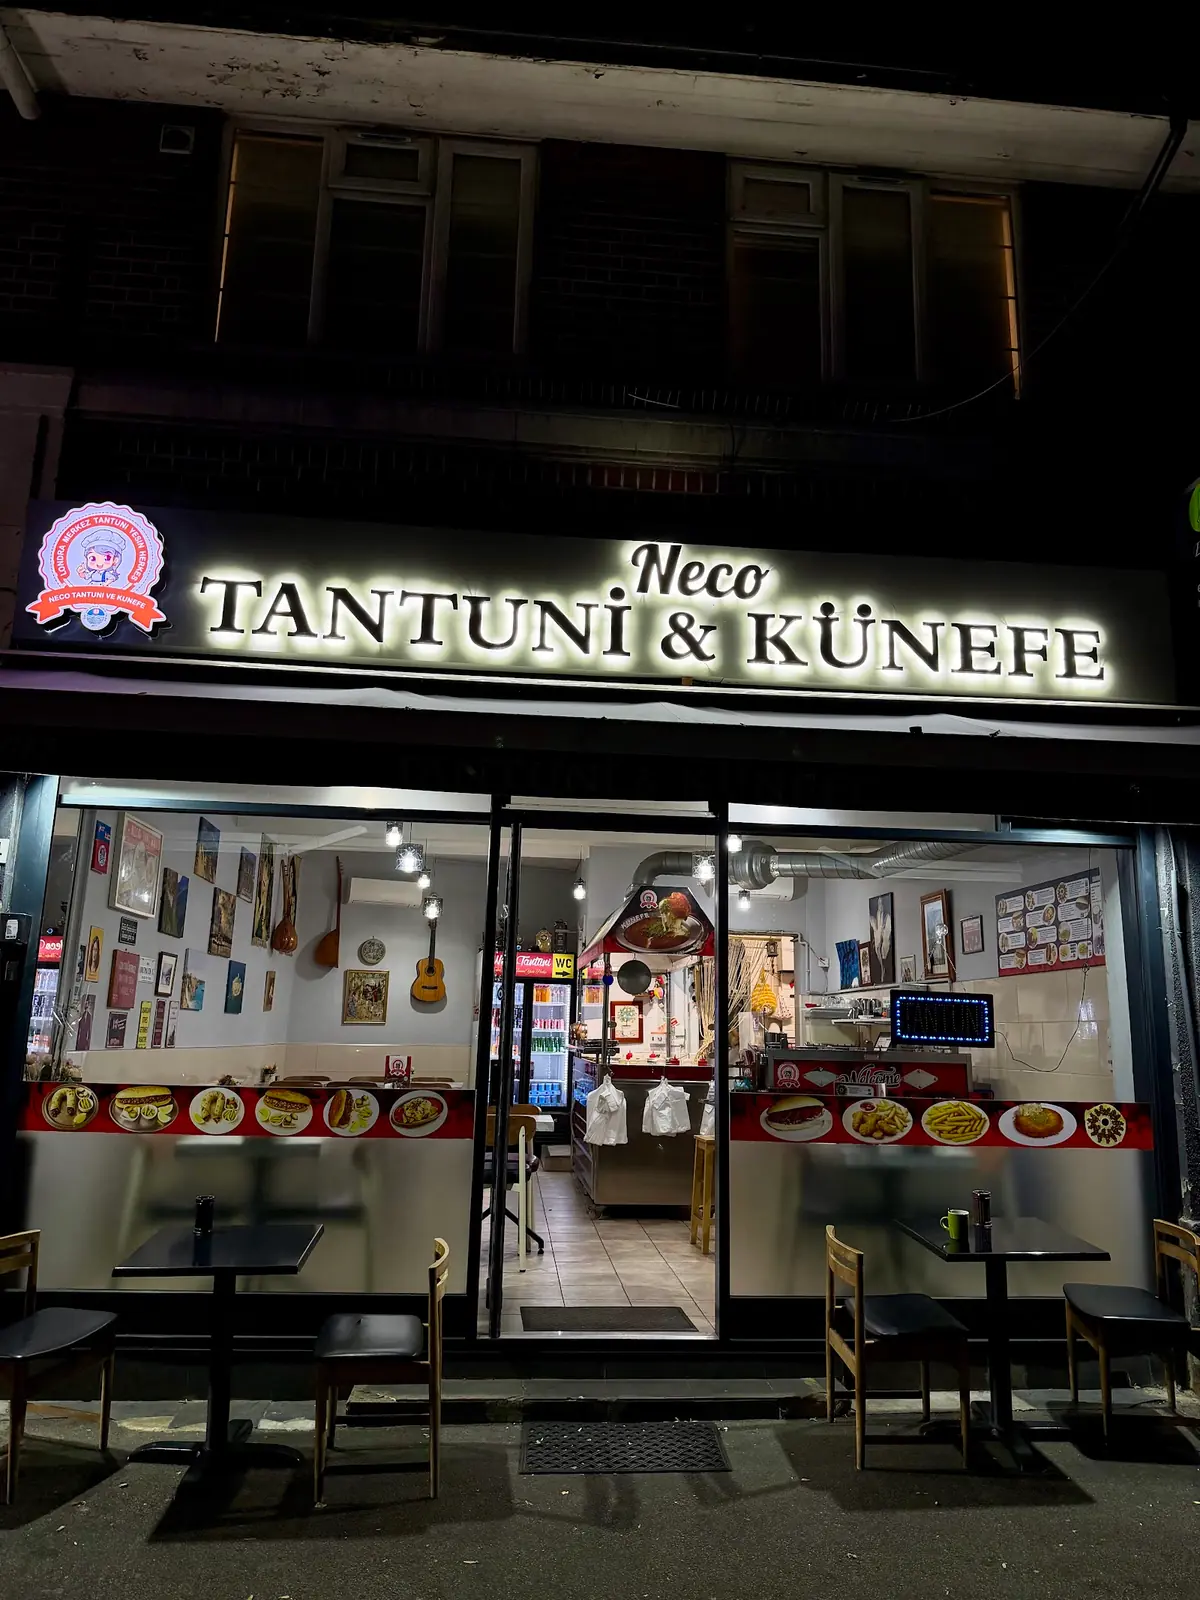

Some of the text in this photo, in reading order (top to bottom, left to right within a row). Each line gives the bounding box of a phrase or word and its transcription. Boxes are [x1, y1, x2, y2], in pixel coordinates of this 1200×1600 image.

[56, 545, 67, 577] LONDRA
[64, 519, 92, 543] MERKEZ
[130, 551, 147, 581] HERKES
[631, 543, 770, 599] Neco
[48, 593, 71, 603] NECO
[106, 592, 116, 600] VE
[660, 612, 717, 661] &
[747, 602, 1105, 681] KÜNEFE
[555, 958, 572, 968] WC
